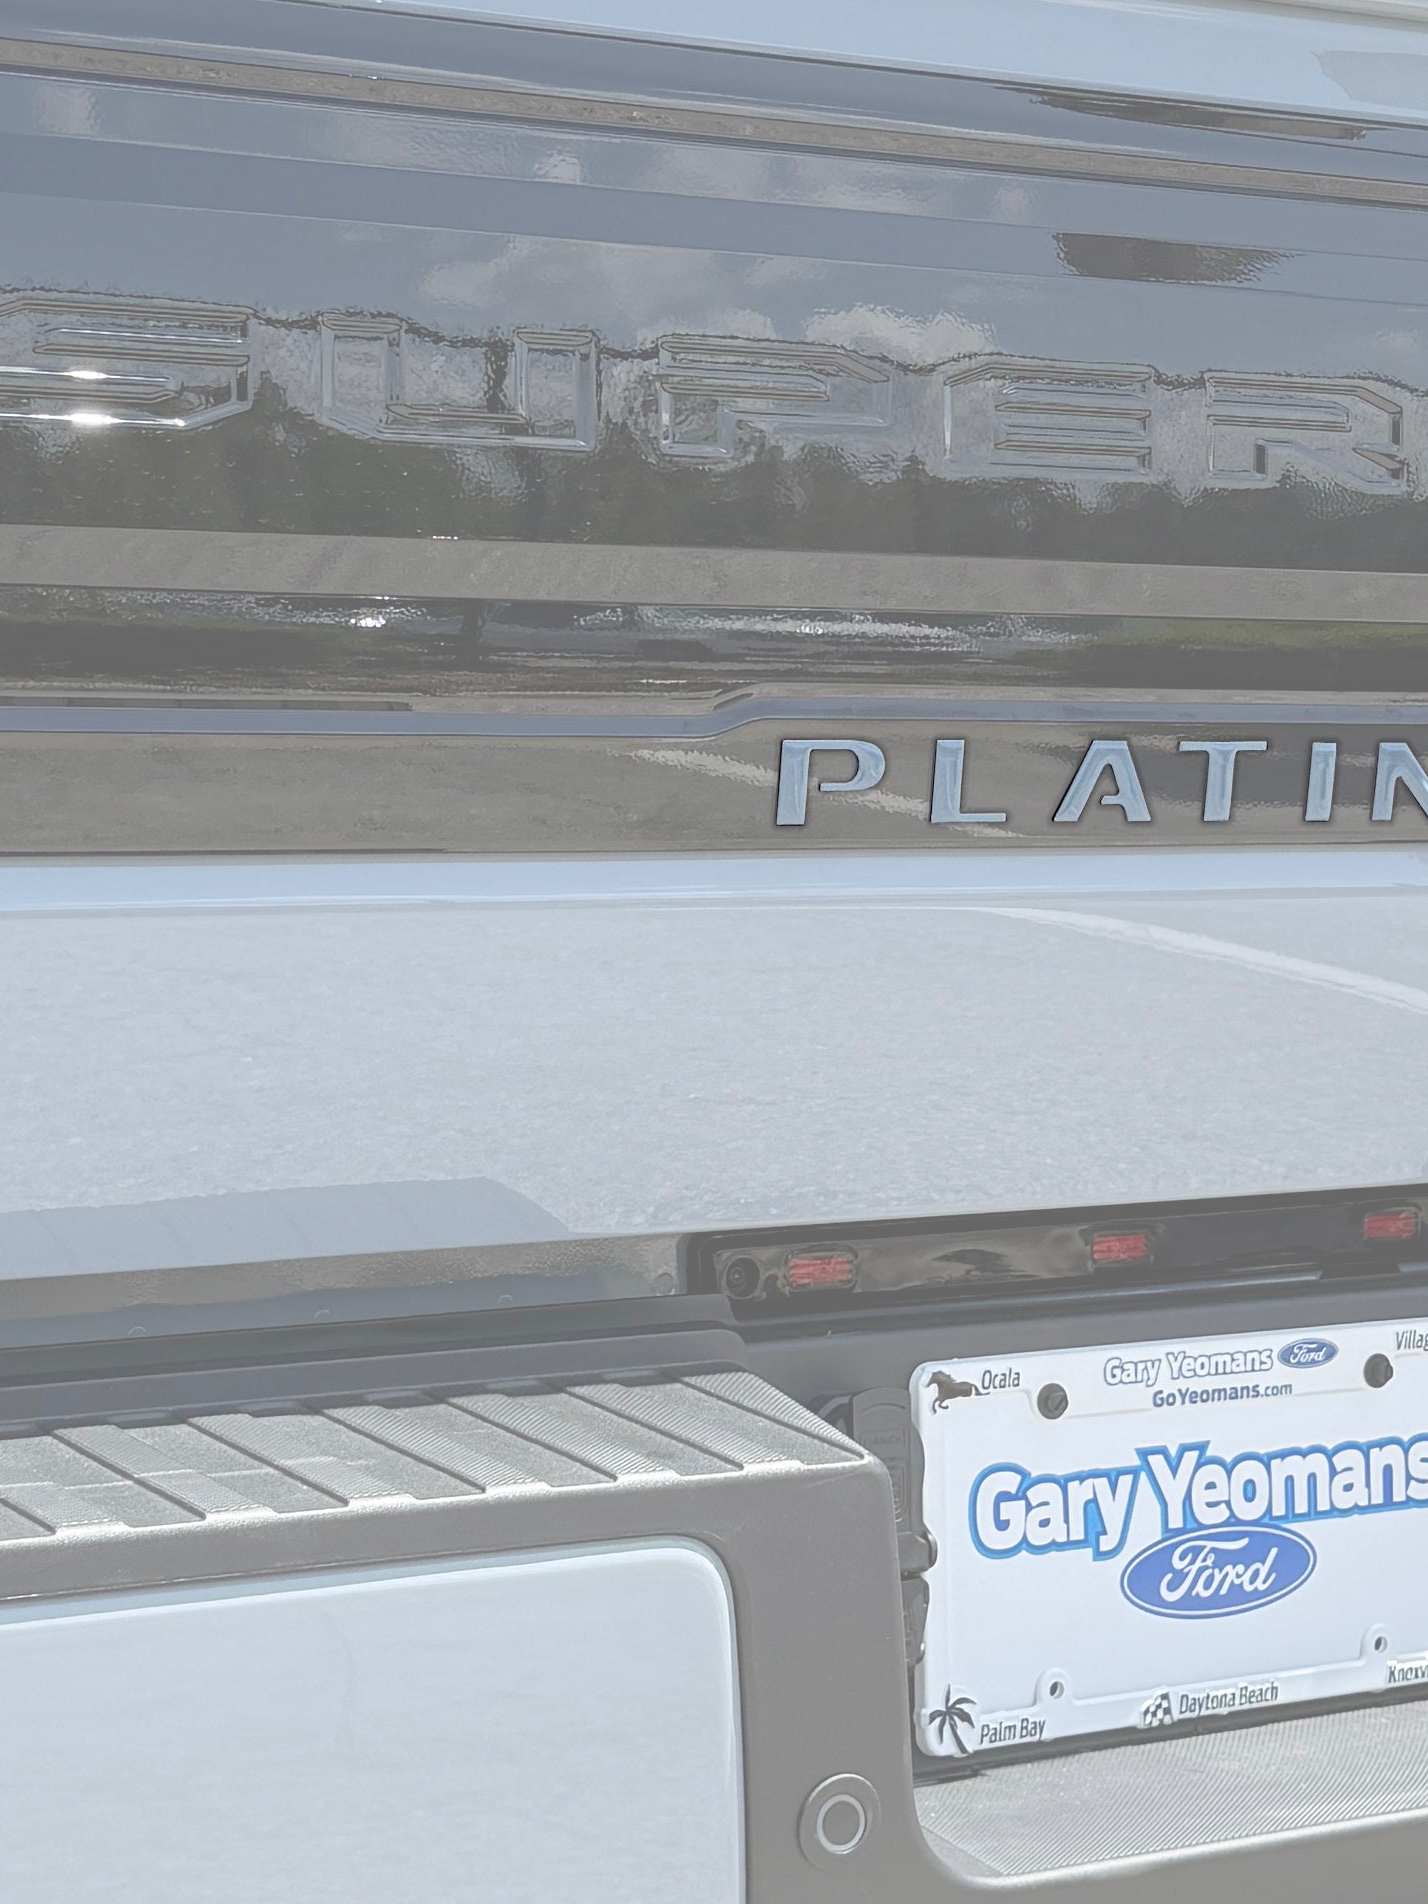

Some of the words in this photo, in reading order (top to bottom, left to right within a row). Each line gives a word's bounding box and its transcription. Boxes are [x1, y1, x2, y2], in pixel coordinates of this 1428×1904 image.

[1104, 1356, 1161, 1386] Gary
[1166, 1347, 1273, 1380] Yeomans
[1289, 1342, 1326, 1364] Ford
[981, 1368, 1021, 1391] Ocala
[1152, 1380, 1294, 1409] GoYeomans.com
[972, 1466, 1140, 1560] Gary
[1159, 1540, 1277, 1599] Ford
[1178, 1693, 1235, 1716] Daytona
[1237, 1683, 1279, 1705] Beach
[979, 1721, 1017, 1744] Palm
[1018, 1716, 1047, 1741] Bay
